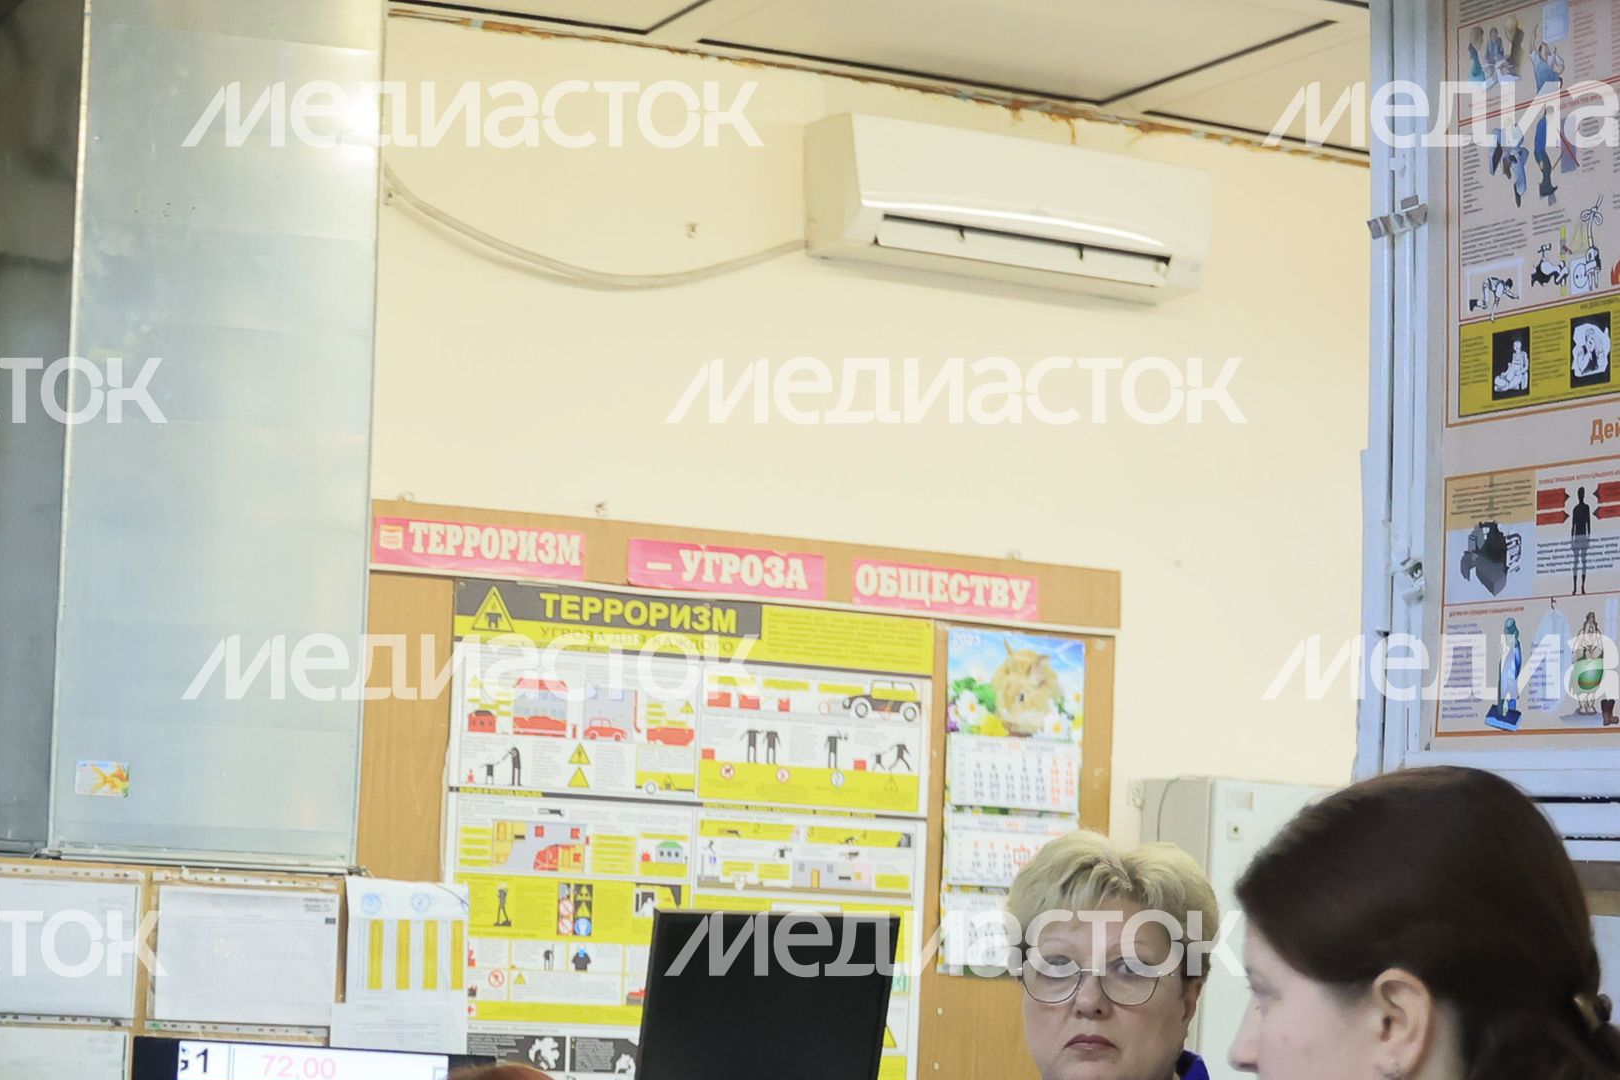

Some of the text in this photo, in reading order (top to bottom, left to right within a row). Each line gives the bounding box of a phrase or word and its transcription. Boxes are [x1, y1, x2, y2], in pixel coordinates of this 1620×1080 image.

[408, 521, 582, 567] ТЕРРОРИЗМ
[679, 549, 808, 592] УГРОЗА
[855, 563, 1032, 611] ОБЩЕСТВУ
[539, 592, 738, 634] ТЕРРОРИЗМ
[262, 1054, 336, 1080] 72,00
